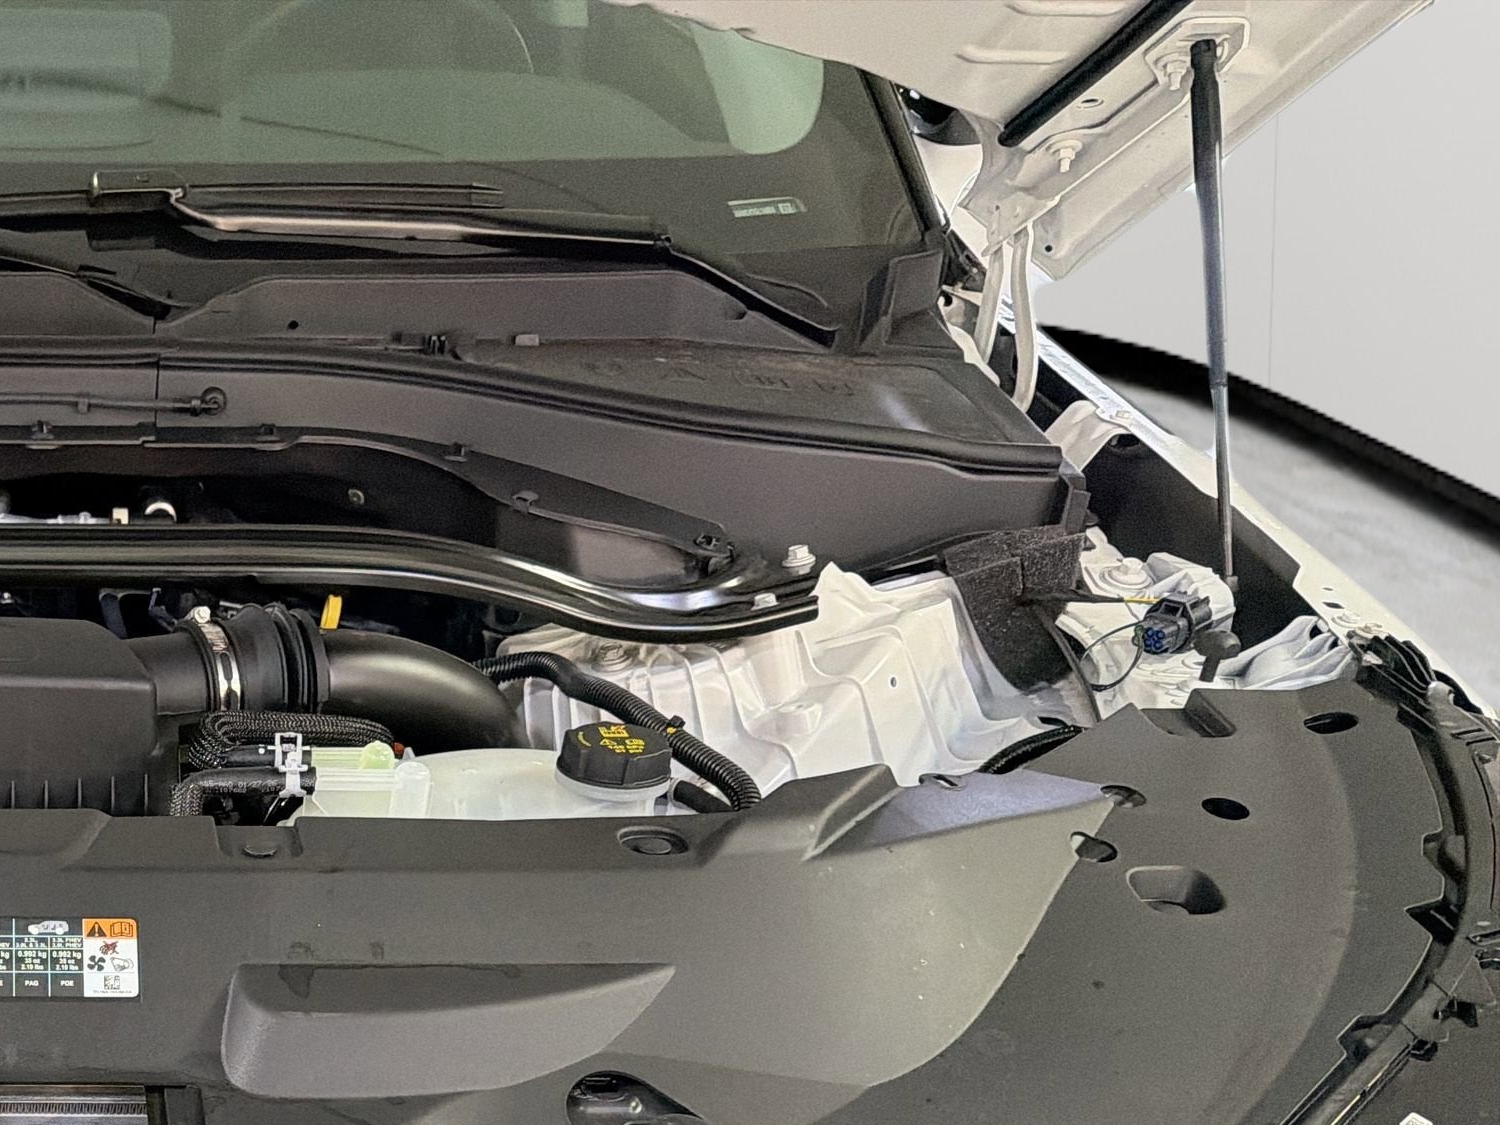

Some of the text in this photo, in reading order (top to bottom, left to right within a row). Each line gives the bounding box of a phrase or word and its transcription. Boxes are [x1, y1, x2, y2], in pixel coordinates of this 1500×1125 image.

[0, 950, 10, 959] kg
[37, 950, 47, 959] kg
[72, 950, 82, 960] kg
